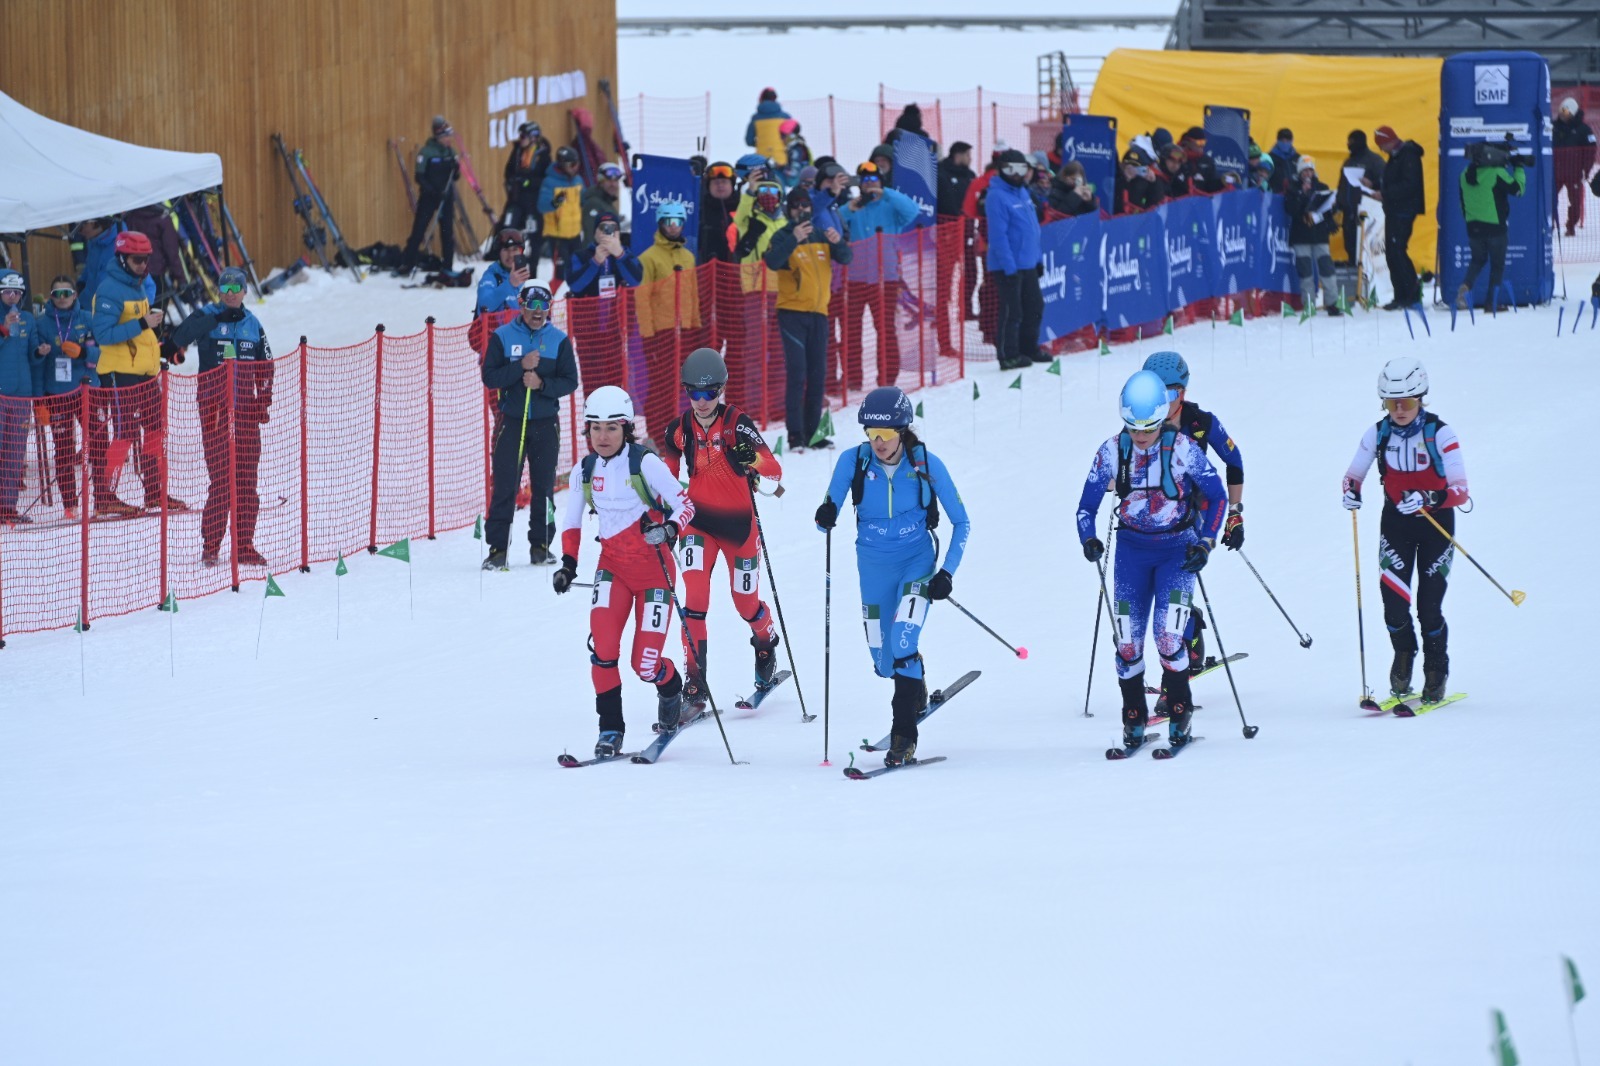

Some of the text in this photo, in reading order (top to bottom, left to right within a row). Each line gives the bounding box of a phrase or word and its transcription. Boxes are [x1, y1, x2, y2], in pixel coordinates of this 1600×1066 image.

[1477, 89, 1507, 101] ISMF
[685, 547, 694, 567] 8
[742, 572, 751, 592] 8
[592, 584, 600, 605] 5
[651, 605, 662, 628] 5
[908, 597, 916, 619] 1
[1175, 607, 1188, 631] 11
